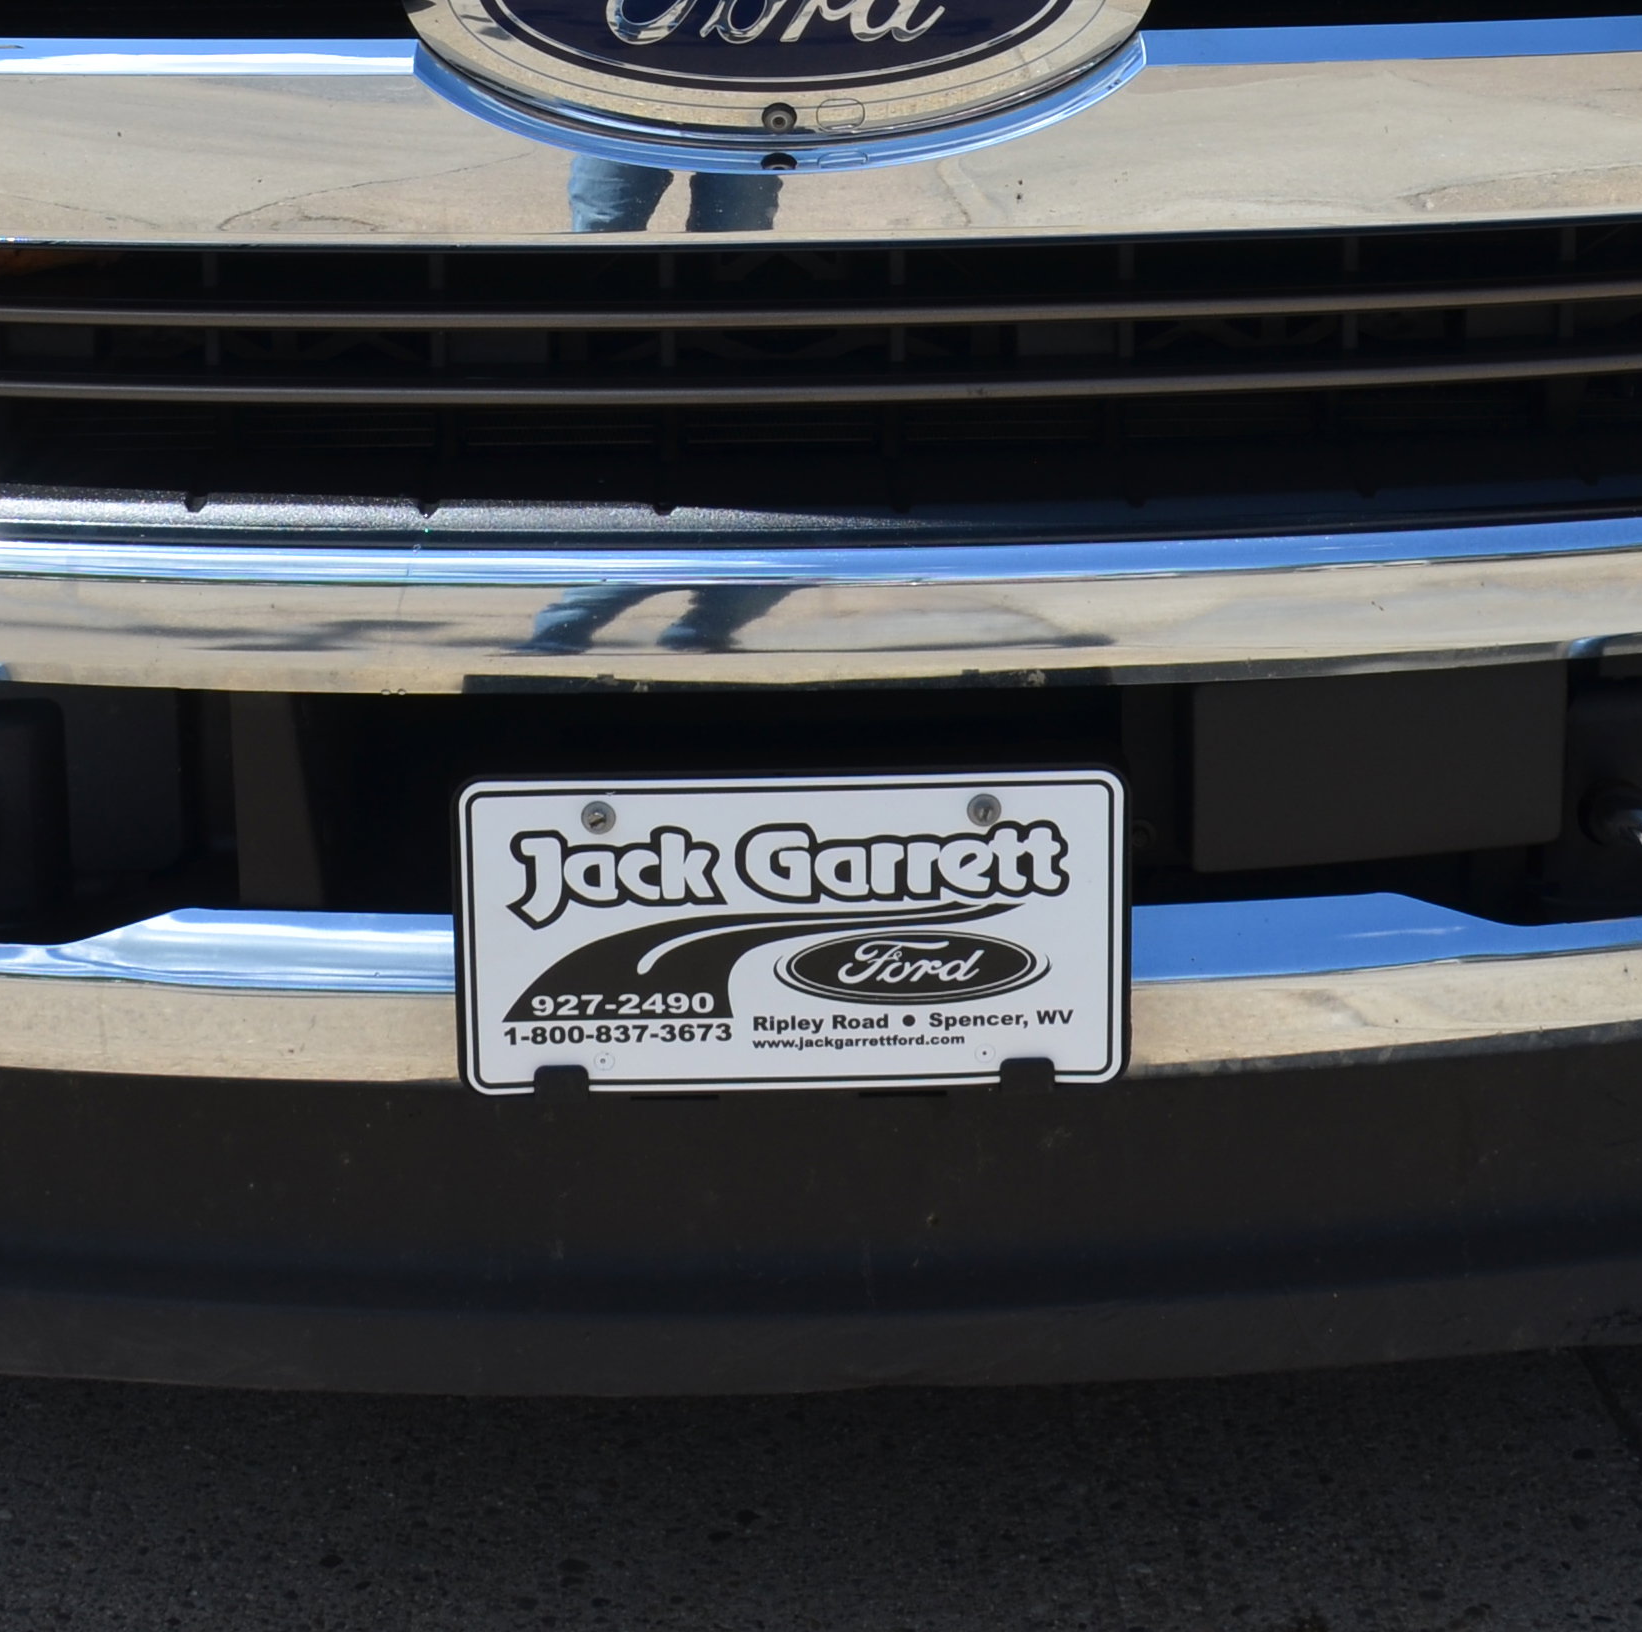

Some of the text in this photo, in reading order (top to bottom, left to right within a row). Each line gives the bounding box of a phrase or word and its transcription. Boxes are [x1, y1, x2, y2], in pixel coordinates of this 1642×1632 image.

[507, 820, 1069, 930] Jack Garrett
[838, 940, 983, 986] Ford
[531, 992, 715, 1016] 927-2490
[504, 1023, 733, 1045] 1-800-837-3673
[753, 1009, 1074, 1035] Ripley Road Spencer, WV
[752, 1034, 965, 1051] www.jackgarrettford.com
